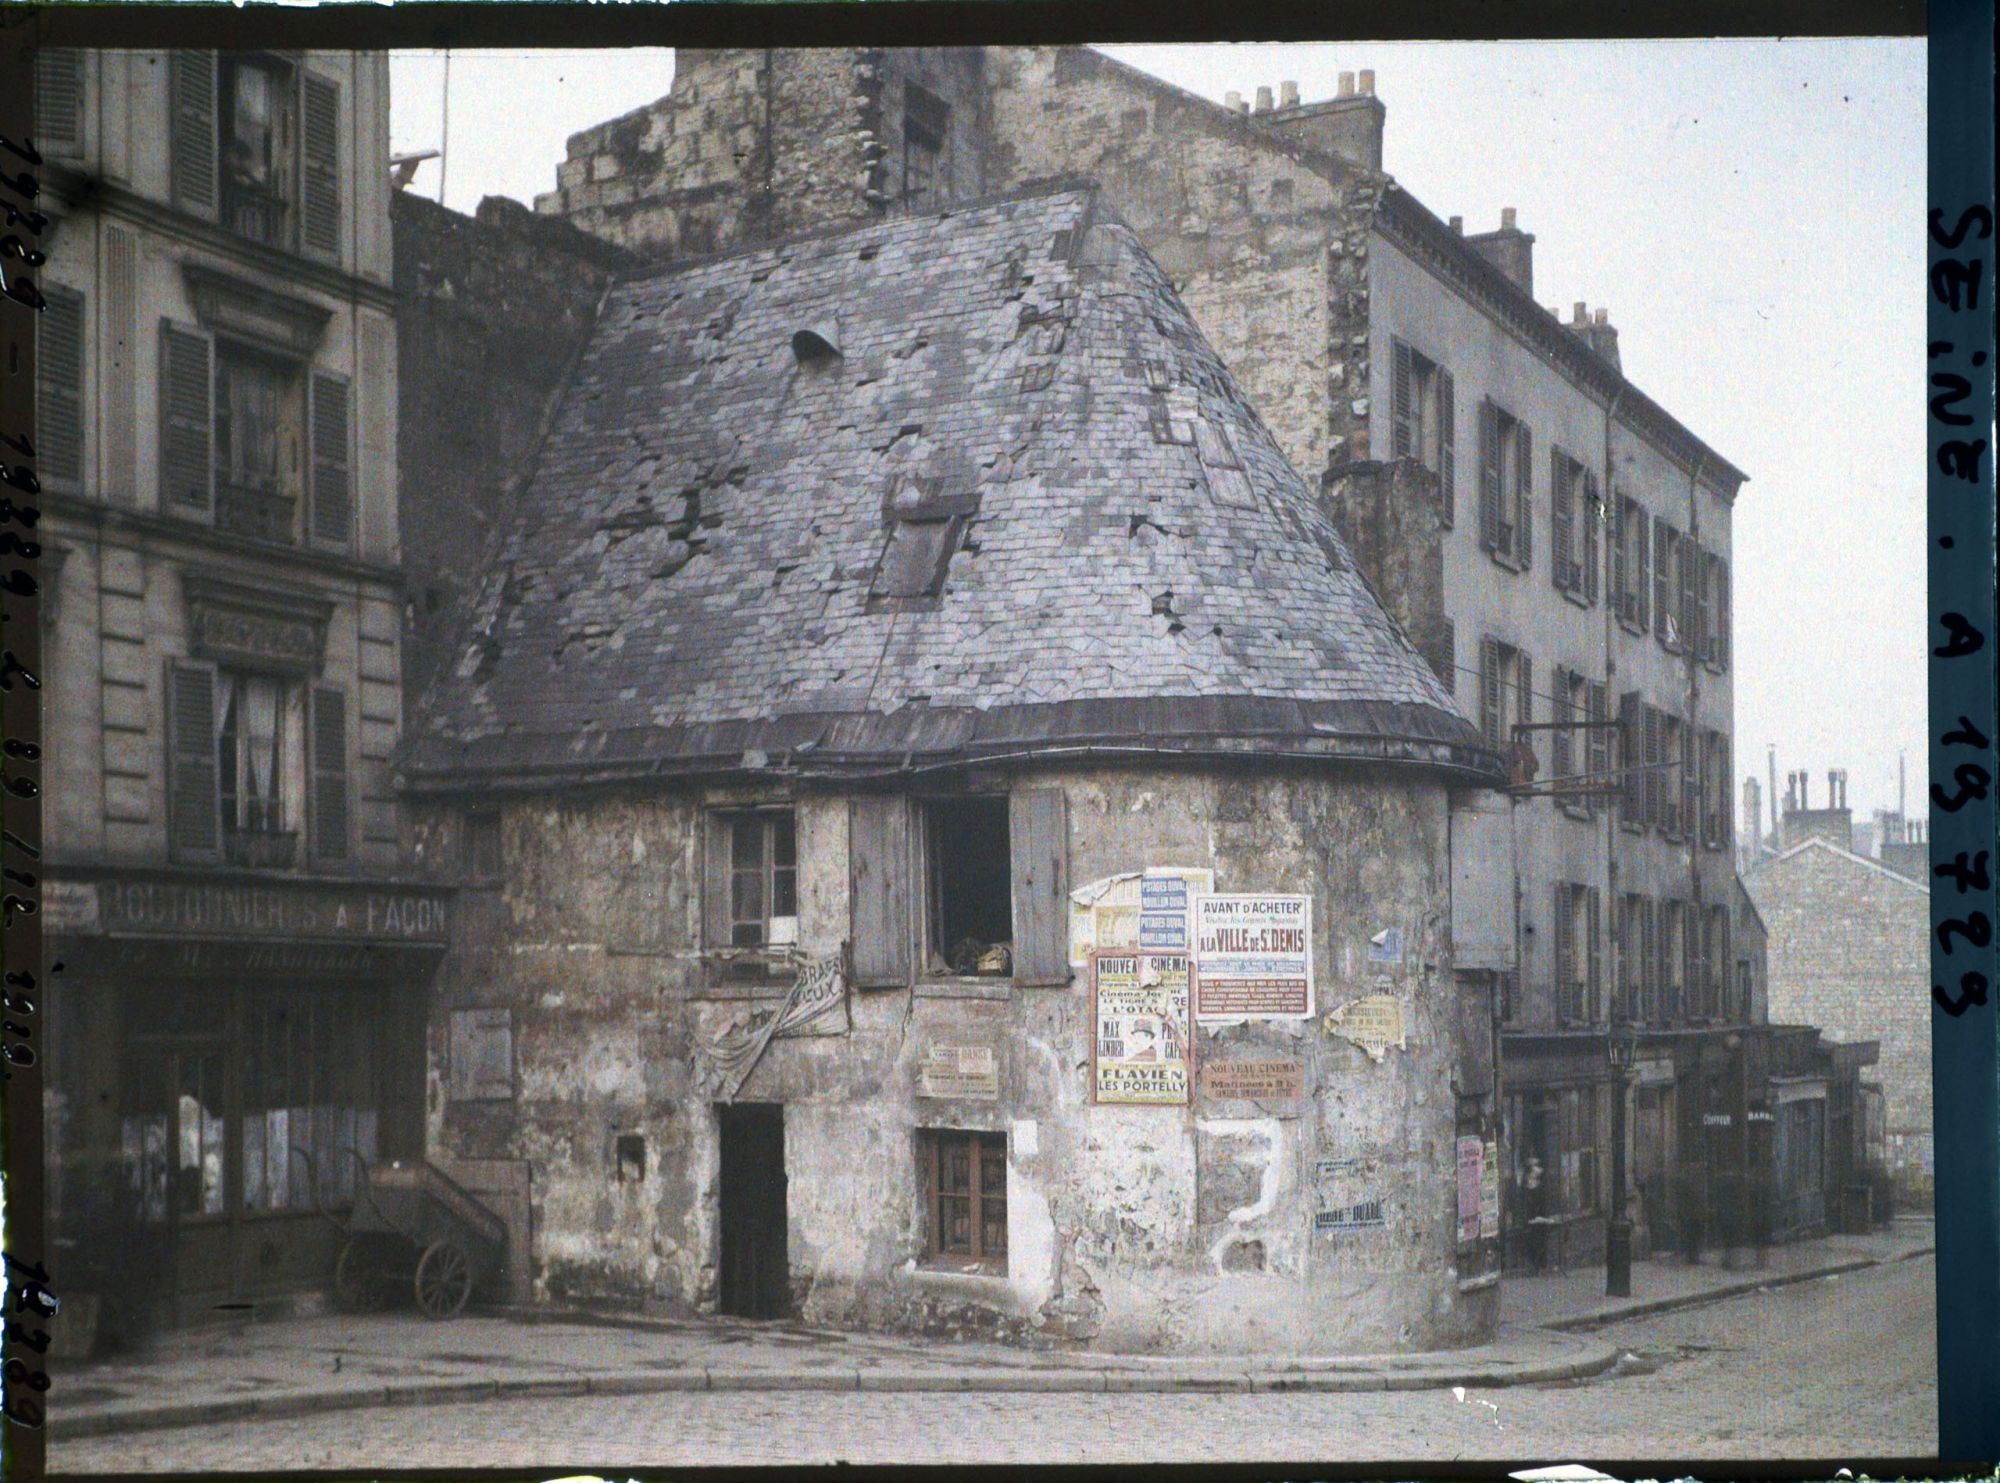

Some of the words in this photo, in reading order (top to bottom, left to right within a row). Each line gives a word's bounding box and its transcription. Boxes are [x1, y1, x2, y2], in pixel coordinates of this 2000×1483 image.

[1933, 612, 1985, 658] A
[367, 897, 446, 934] FAÇON
[1204, 902, 1239, 913] AVANT
[1243, 902, 1300, 914] D'ACHETER
[1200, 938, 1206, 952] A
[1207, 938, 1216, 952] LA
[1216, 928, 1249, 952] VILLE
[1250, 938, 1259, 952] DE
[1271, 928, 1304, 952] DENIS
[1100, 960, 1137, 973] NOUVEA
[1104, 1021, 1120, 1038] MAX
[1099, 1040, 1124, 1057] LINDER
[1103, 1069, 1182, 1079] FLAVIEN
[1210, 1064, 1253, 1073] NOUVEAU
[1099, 1081, 1118, 1091] LES
